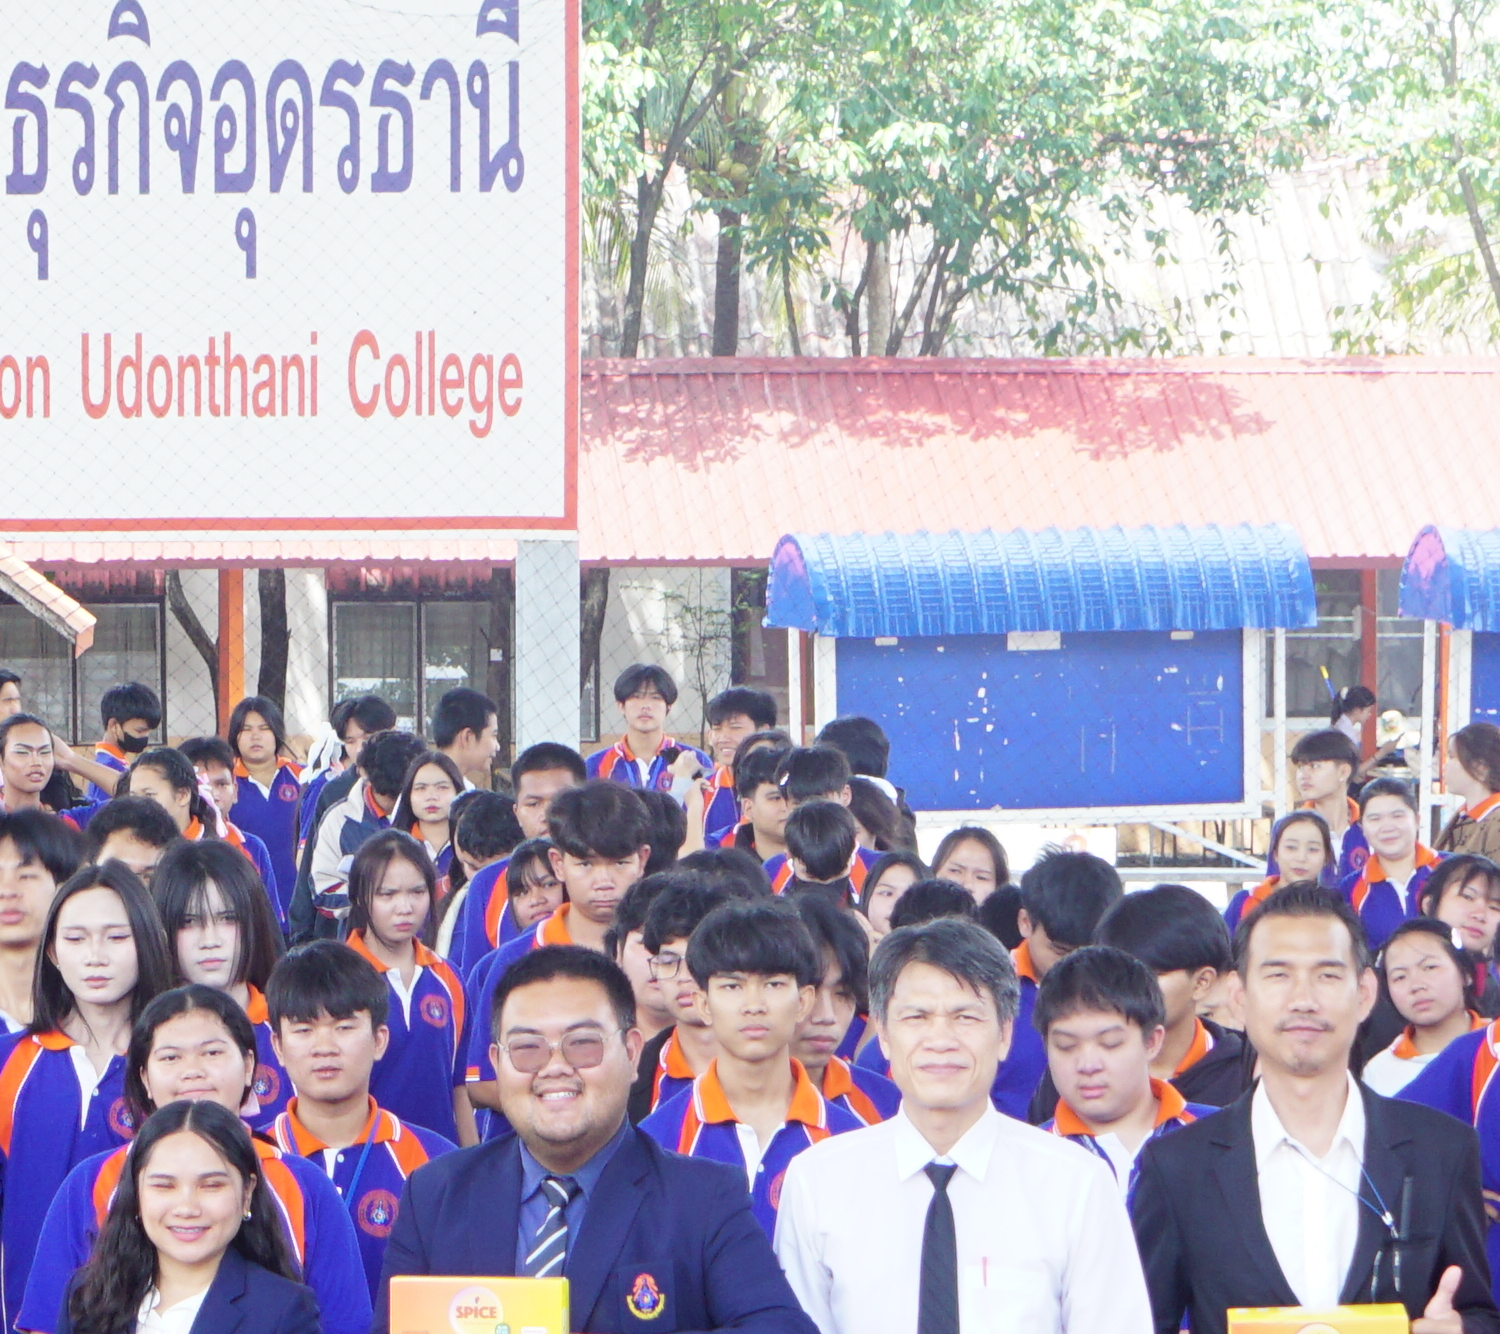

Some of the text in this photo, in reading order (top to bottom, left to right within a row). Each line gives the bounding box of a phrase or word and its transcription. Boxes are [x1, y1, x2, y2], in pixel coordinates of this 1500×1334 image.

[80, 330, 318, 419] Udonthani
[347, 328, 524, 439] College
[455, 1305, 498, 1319] SPICE
